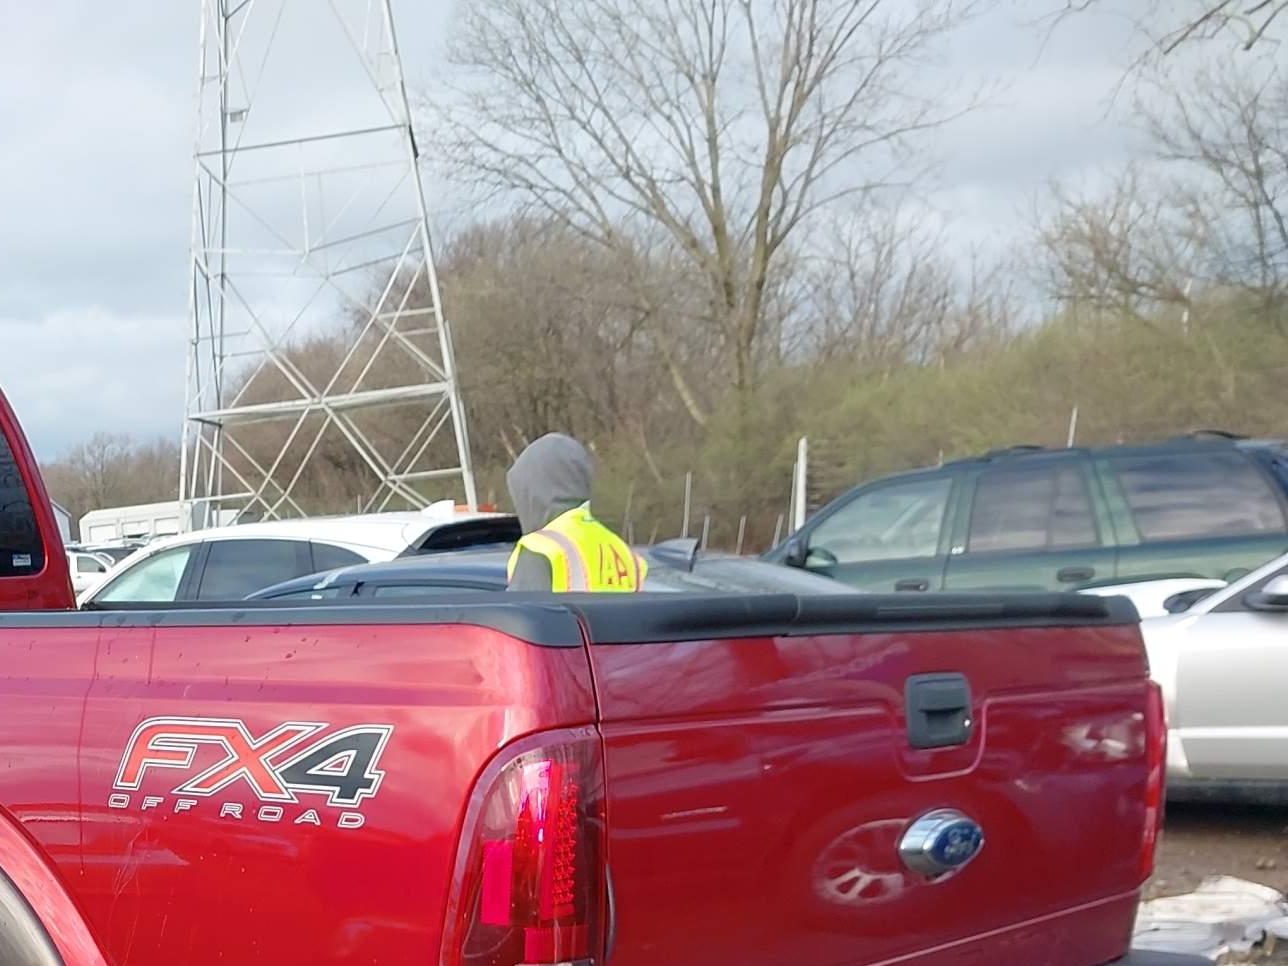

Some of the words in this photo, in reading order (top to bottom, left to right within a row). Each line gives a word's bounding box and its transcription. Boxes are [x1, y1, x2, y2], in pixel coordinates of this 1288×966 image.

[112, 716, 395, 809] FX4
[108, 793, 198, 815] OFF
[219, 802, 366, 829] ROAD
